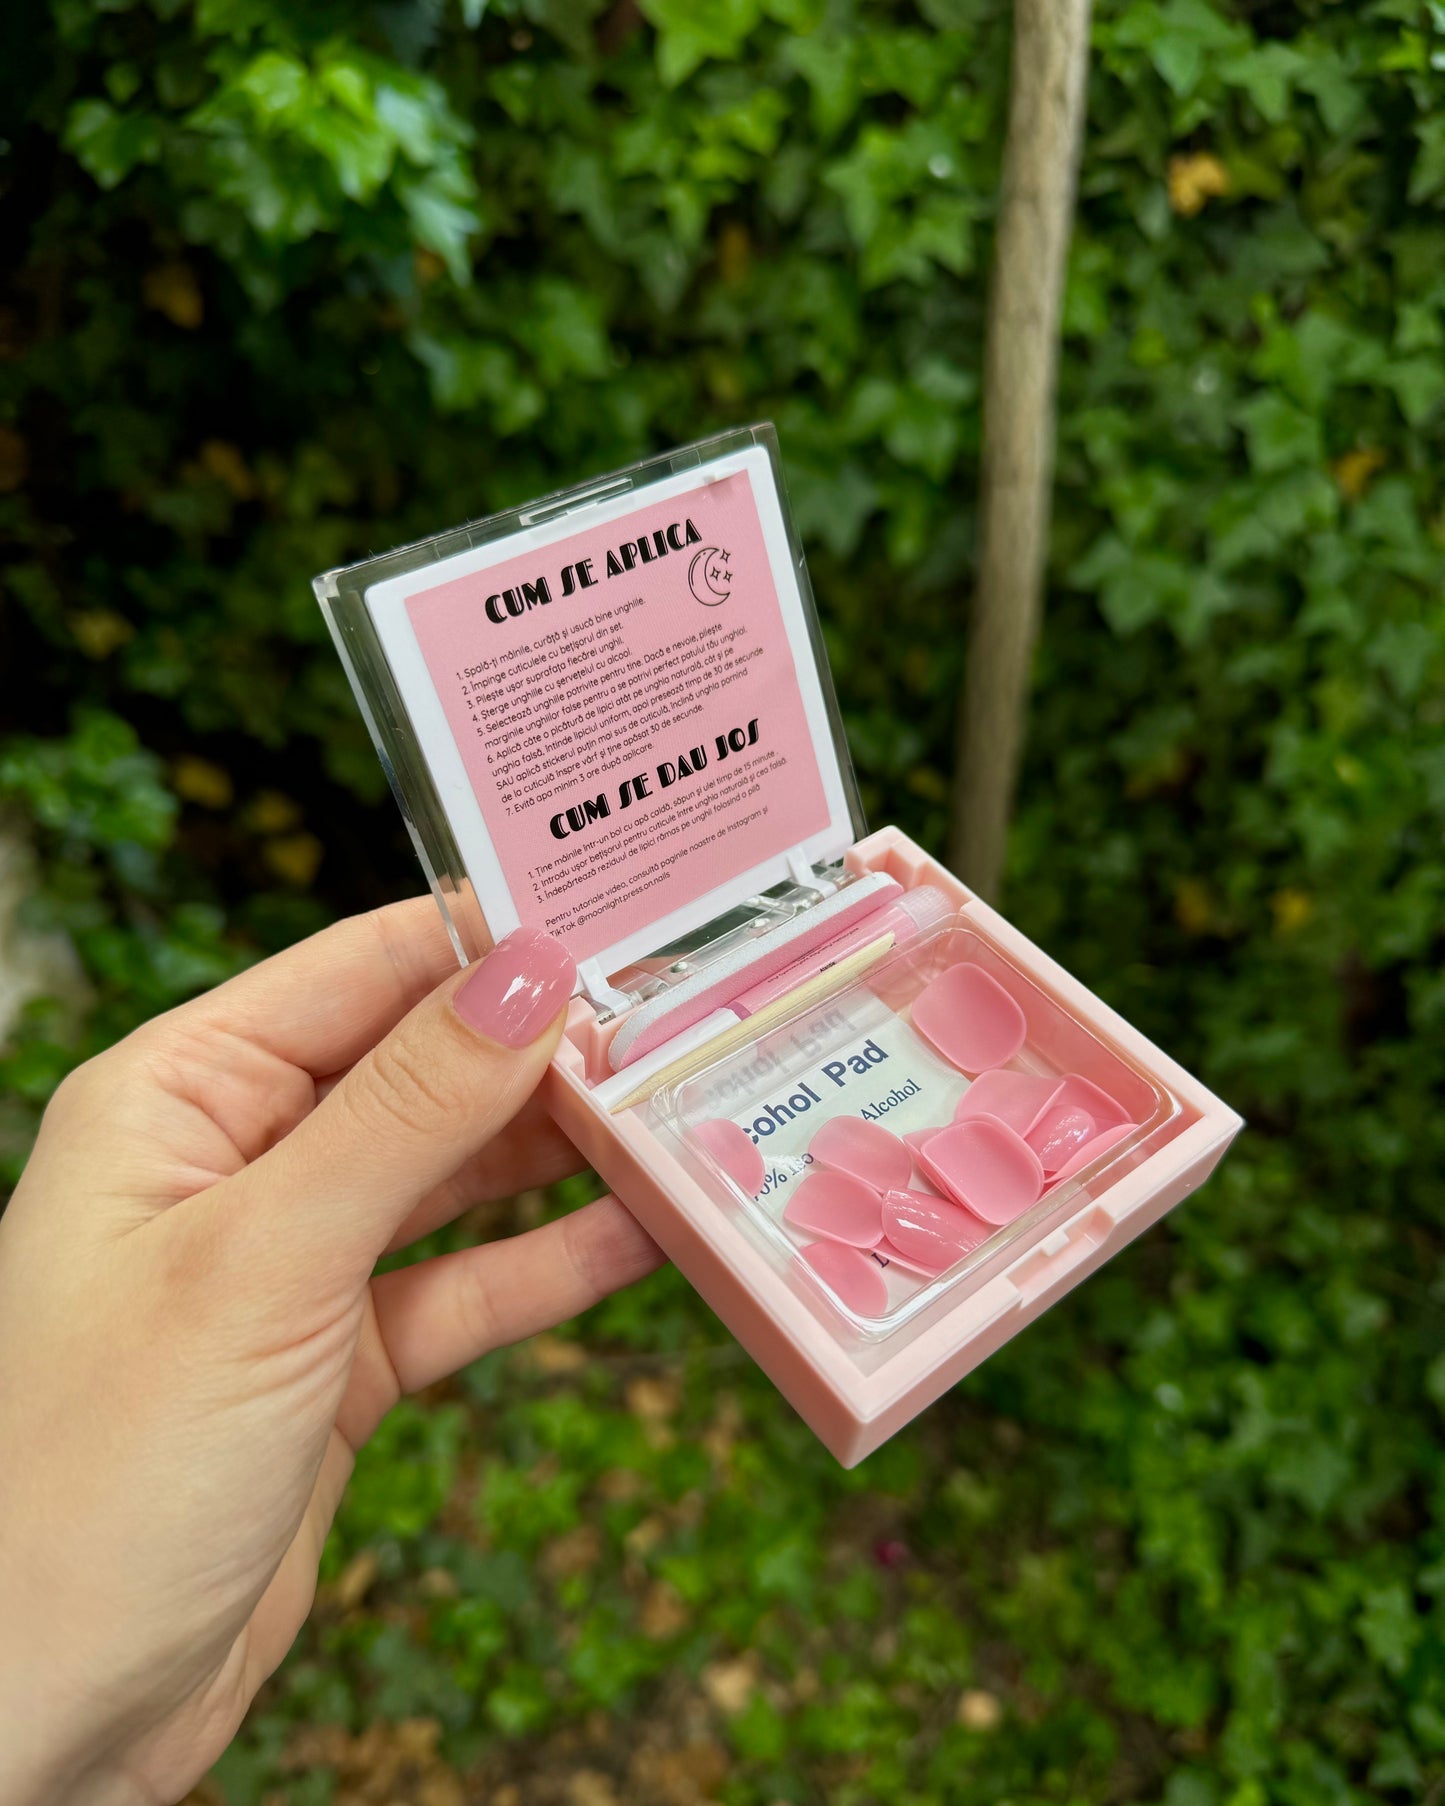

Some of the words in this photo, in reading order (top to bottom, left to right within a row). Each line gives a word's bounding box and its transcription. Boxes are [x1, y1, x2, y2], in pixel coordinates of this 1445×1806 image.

[485, 577, 552, 624] CUM
[561, 558, 598, 597] SE
[607, 519, 702, 579] APLICA
[508, 654, 548, 676] cuticulele
[548, 649, 559, 659] cu
[596, 628, 609, 639] din
[594, 610, 613, 624] bine
[484, 727, 524, 750] marginile
[525, 710, 560, 731] unghiilor
[561, 702, 583, 715] false
[583, 689, 609, 708] pentru
[617, 681, 627, 691] se
[628, 668, 652, 688] potrivi
[652, 656, 680, 676] perfect
[681, 644, 706, 664] patului
[492, 760, 521, 777] unghia
[572, 722, 598, 740] lipiciul
[632, 699, 649, 713] apoi
[685, 676, 702, 691] timp
[703, 671, 713, 680] de
[713, 665, 723, 676] 30
[724, 661, 734, 671] de
[734, 648, 764, 666] secunde
[511, 687, 543, 706] unghiile
[544, 682, 555, 692] cu
[596, 660, 606, 670] cu
[533, 693, 565, 712] unghiile
[566, 679, 599, 700] potrivite
[600, 667, 626, 685] pentru
[585, 710, 596, 720] de
[596, 700, 614, 715] lipici
[632, 689, 643, 701] pe
[644, 676, 671, 693] unghia
[724, 647, 734, 658] pe
[496, 776, 514, 790] SAU
[542, 747, 576, 769] stickerul
[598, 730, 613, 745] mai
[614, 725, 627, 736] sus
[628, 720, 639, 731] de
[695, 682, 720, 698] unghia
[721, 667, 748, 688] pornind
[501, 794, 513, 803] de
[513, 789, 522, 799] la
[650, 723, 660, 734] 30
[661, 719, 671, 728] de
[536, 790, 553, 802] apa
[554, 778, 579, 794] minim
[579, 773, 585, 782] 3
[586, 768, 600, 781] ore
[550, 793, 611, 839] CUM
[619, 772, 653, 809] SE
[656, 745, 707, 788] DAU
[715, 718, 759, 761] JOS
[541, 868, 570, 887] Introdu
[623, 829, 648, 848] pentru
[648, 814, 677, 833] cuticule
[597, 851, 627, 873] reziduul
[628, 848, 638, 859] de
[639, 837, 656, 854] lipici
[681, 820, 691, 832] pe
[609, 826, 622, 839] bol
[623, 822, 633, 832] cu
[545, 910, 571, 927] Pentru
[572, 893, 606, 913] tutoriale
[660, 849, 688, 869] paginile
[689, 834, 716, 852] noastre
[549, 921, 576, 937] TikTok
[821, 1039, 889, 1087] Pad
[754, 1167, 788, 1202] 0%
[860, 1079, 922, 1121] Alcohol
